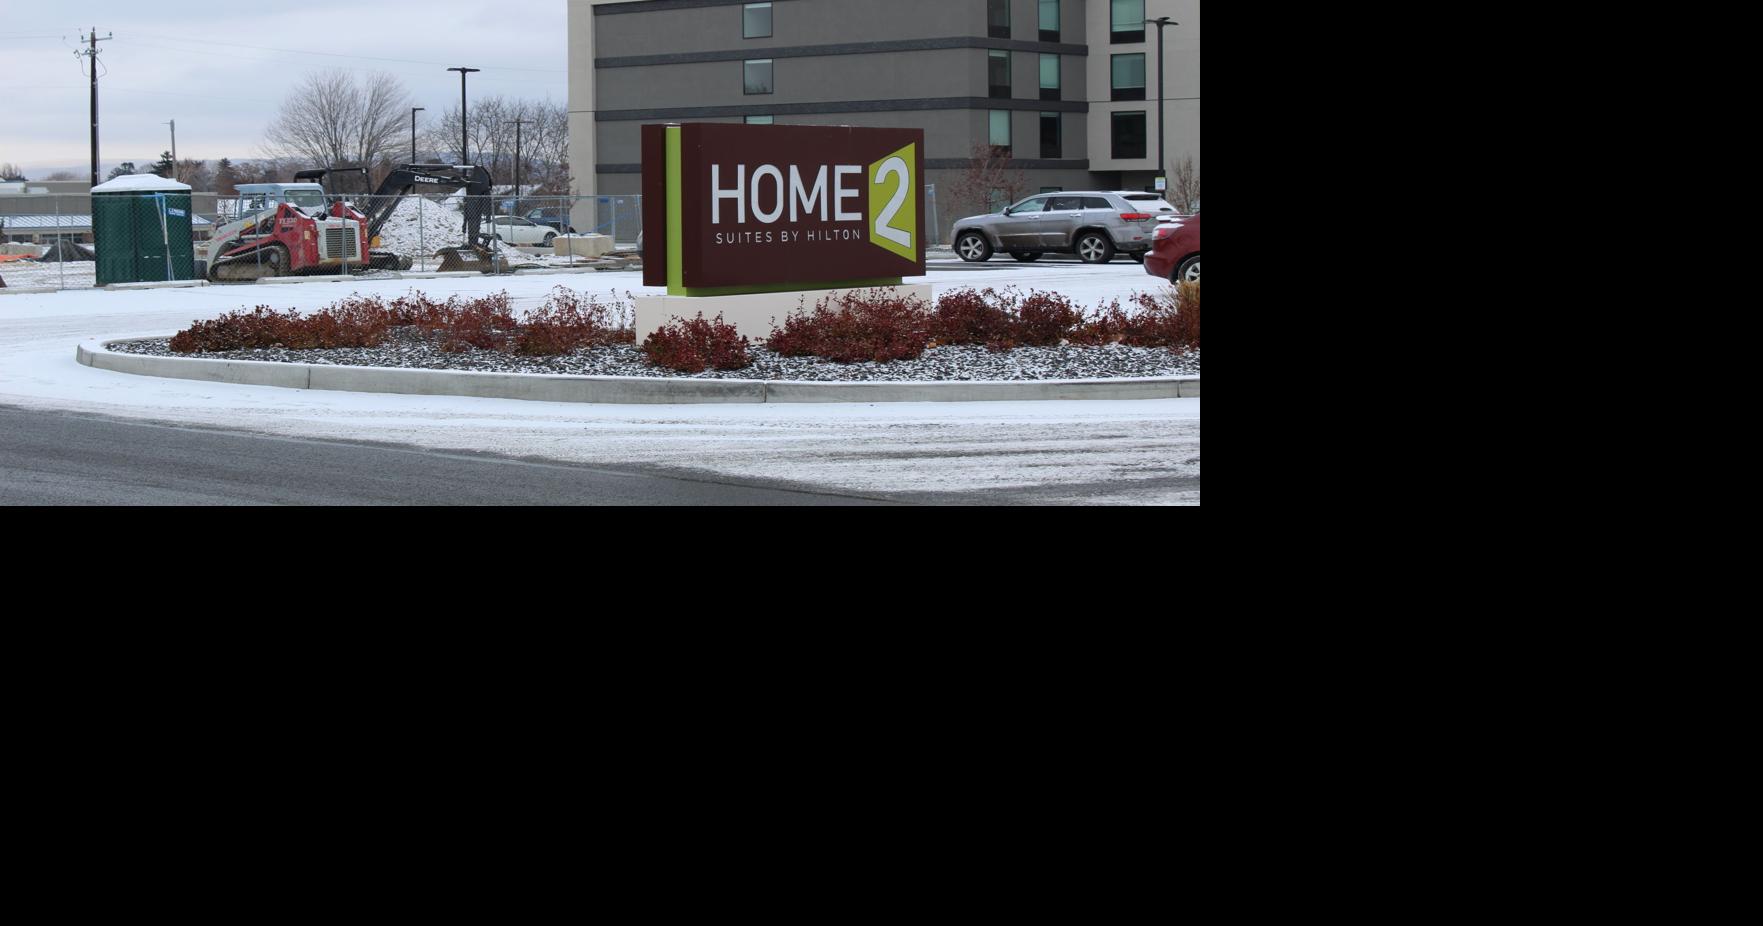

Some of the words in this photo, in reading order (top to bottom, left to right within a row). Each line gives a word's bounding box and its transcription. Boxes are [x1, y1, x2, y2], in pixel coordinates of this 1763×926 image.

[414, 175, 439, 184] DEERE
[711, 164, 863, 224] HOME
[874, 156, 912, 249] 2
[715, 231, 773, 244] SUITES
[781, 231, 799, 242] BY
[807, 229, 860, 241] HILTON
